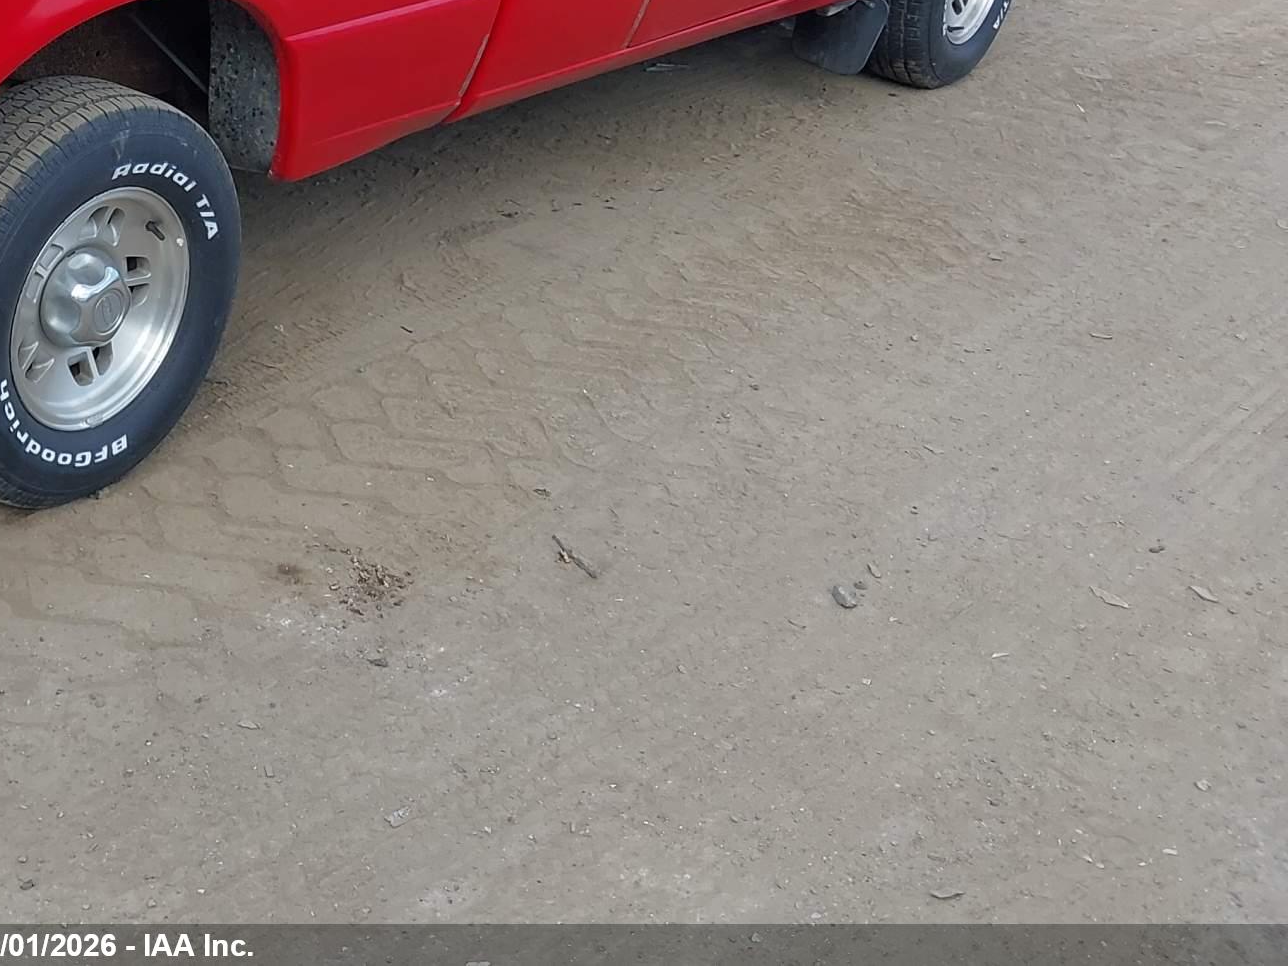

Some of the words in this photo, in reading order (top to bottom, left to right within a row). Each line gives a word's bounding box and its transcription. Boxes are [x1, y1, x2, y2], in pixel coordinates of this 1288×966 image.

[111, 161, 198, 192] Radial
[196, 193, 219, 240] T/A
[0, 378, 128, 468] BFGoodrich
